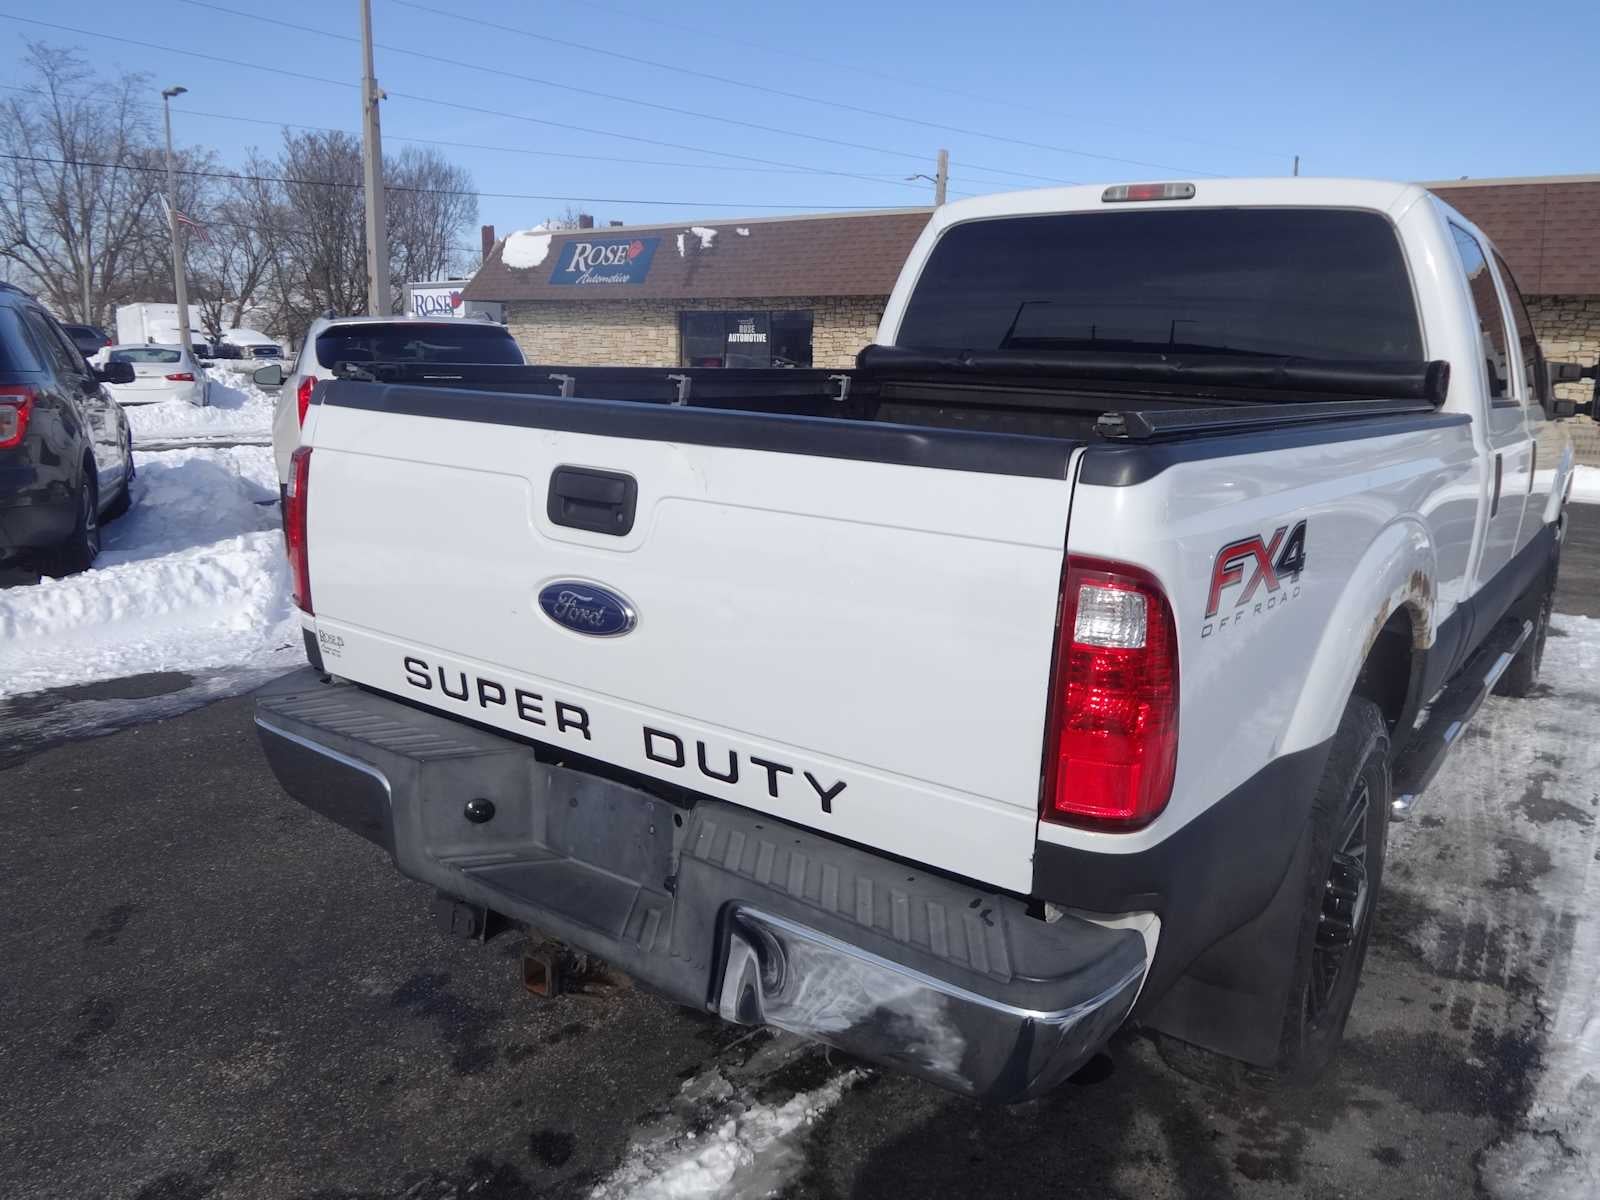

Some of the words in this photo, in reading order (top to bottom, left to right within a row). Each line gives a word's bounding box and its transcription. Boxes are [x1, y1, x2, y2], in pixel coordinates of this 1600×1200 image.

[565, 243, 629, 272] ROSE
[576, 267, 631, 284] Automotive
[413, 294, 451, 317] ROSE
[728, 333, 767, 342] AUTOMOTIVE
[1204, 518, 1307, 619] FX4
[553, 590, 605, 627] Ford
[1201, 611, 1244, 639] OFF
[1254, 586, 1301, 614] ROAD
[403, 655, 592, 741] SUPER
[643, 726, 847, 814] DUTY
